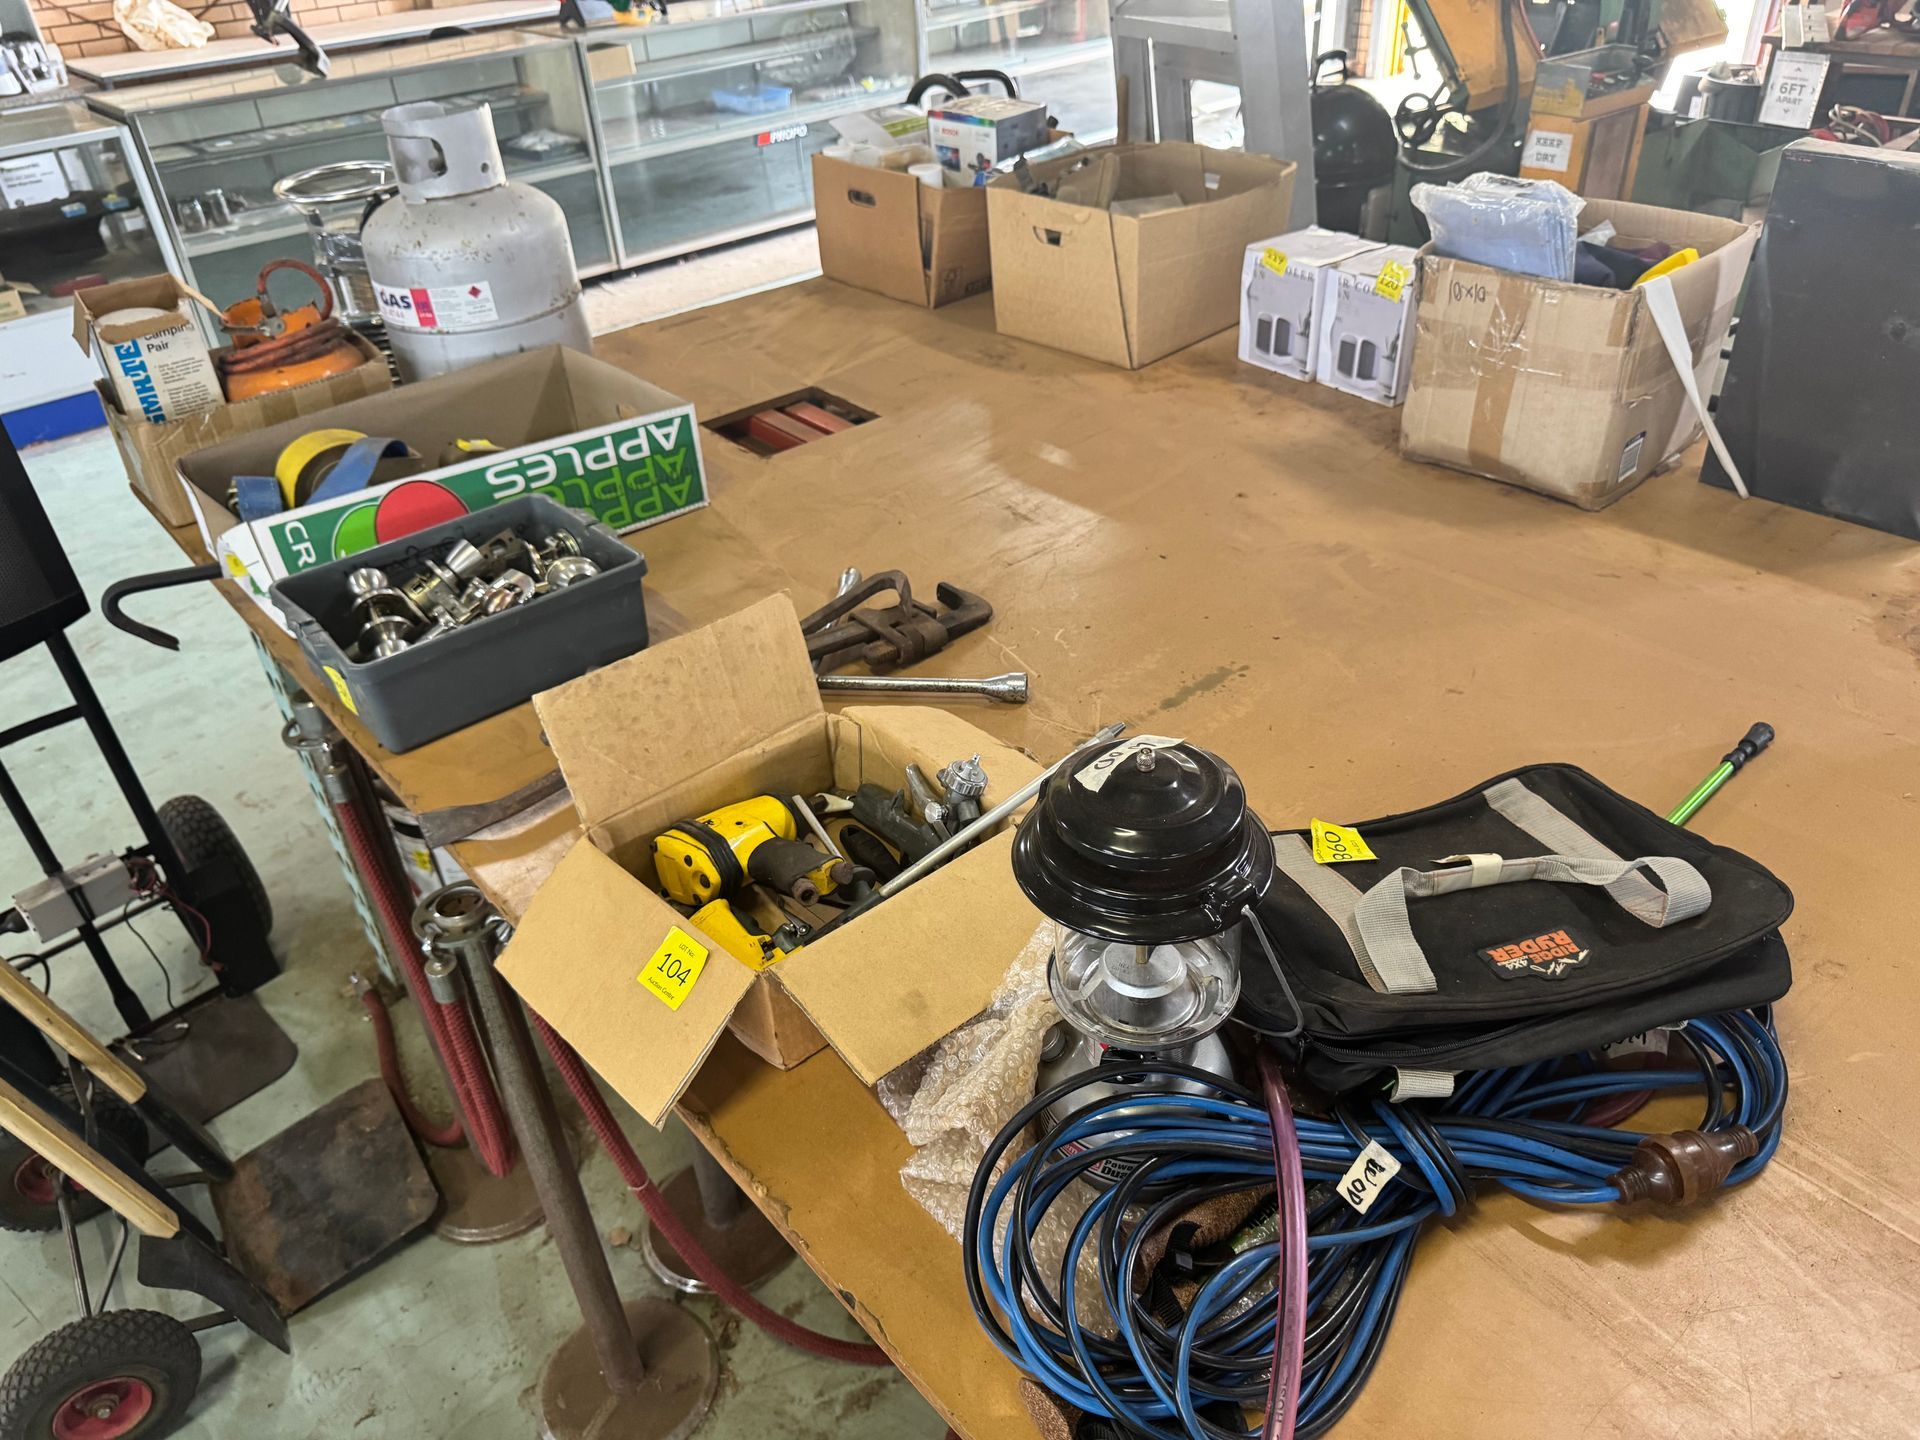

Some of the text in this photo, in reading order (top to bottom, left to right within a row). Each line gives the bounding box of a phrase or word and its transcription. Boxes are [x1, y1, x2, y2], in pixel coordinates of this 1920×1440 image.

[1779, 82, 1807, 96] 6FT
[1776, 95, 1803, 105] APART
[1535, 137, 1564, 149] KEEP
[1535, 152, 1557, 163] DRY
[146, 341, 169, 353] Pair
[485, 417, 682, 499] APPLES
[678, 943, 689, 952] LOT
[1486, 929, 1573, 962] RYDER
[1527, 942, 1581, 964] RIDGE
[657, 953, 692, 987] 104
[648, 976, 675, 1000] Auction Centre
